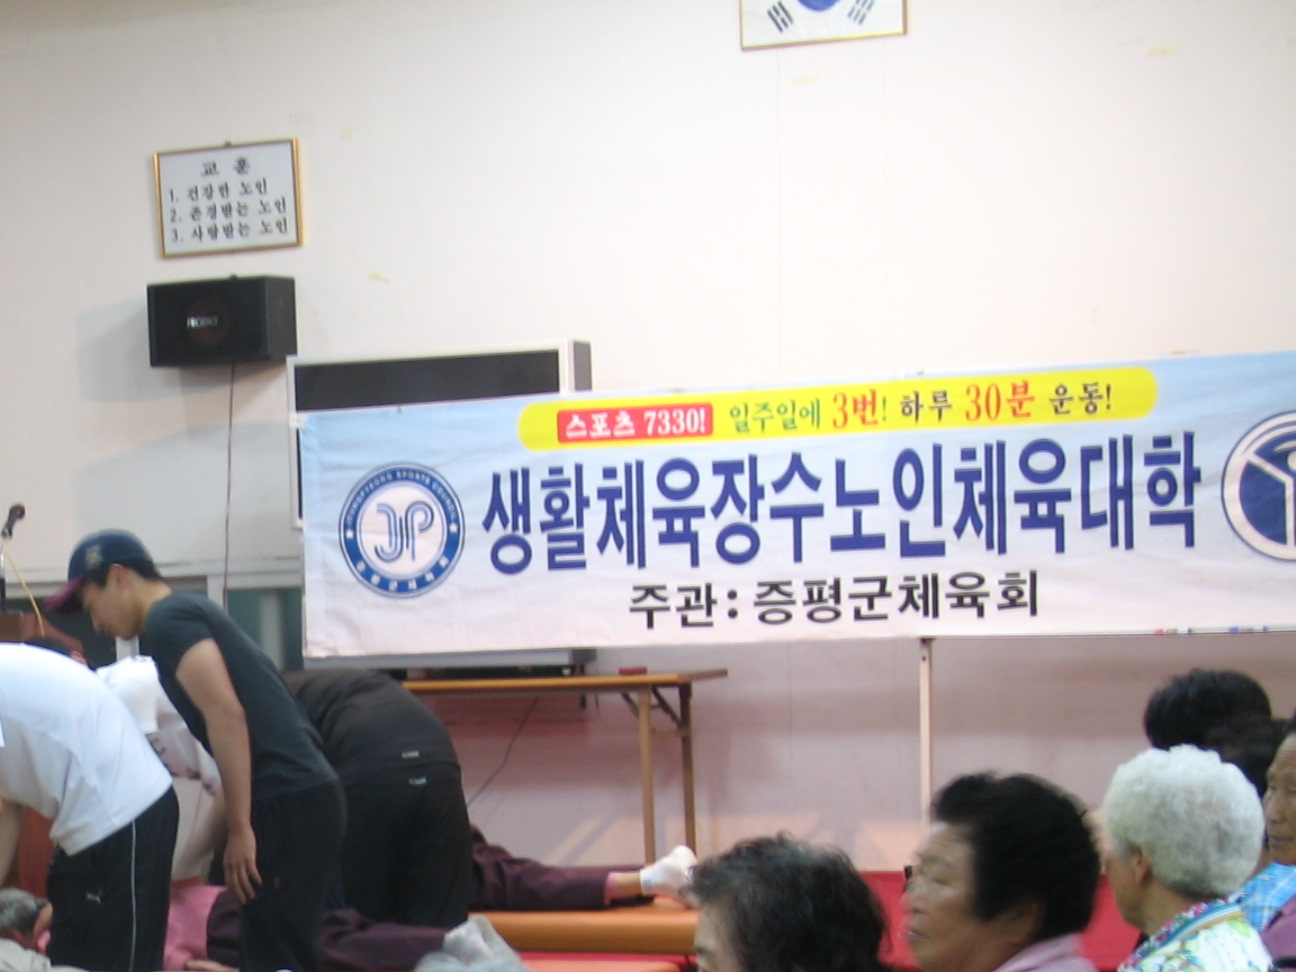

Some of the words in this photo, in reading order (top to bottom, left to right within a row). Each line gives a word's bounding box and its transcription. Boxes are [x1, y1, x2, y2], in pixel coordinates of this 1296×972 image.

[240, 178, 267, 195] 노인
[259, 197, 286, 214] 노인
[192, 221, 251, 242] 사랑받는
[260, 217, 288, 234] 노인
[566, 410, 635, 438] 스포츠
[644, 407, 707, 435] 7330!
[729, 398, 821, 433] 일주일에
[900, 390, 953, 424] 하루
[965, 380, 1036, 421] 30분
[1049, 382, 1111, 416] 운동!
[753, 570, 1038, 626] 증평군체육회
